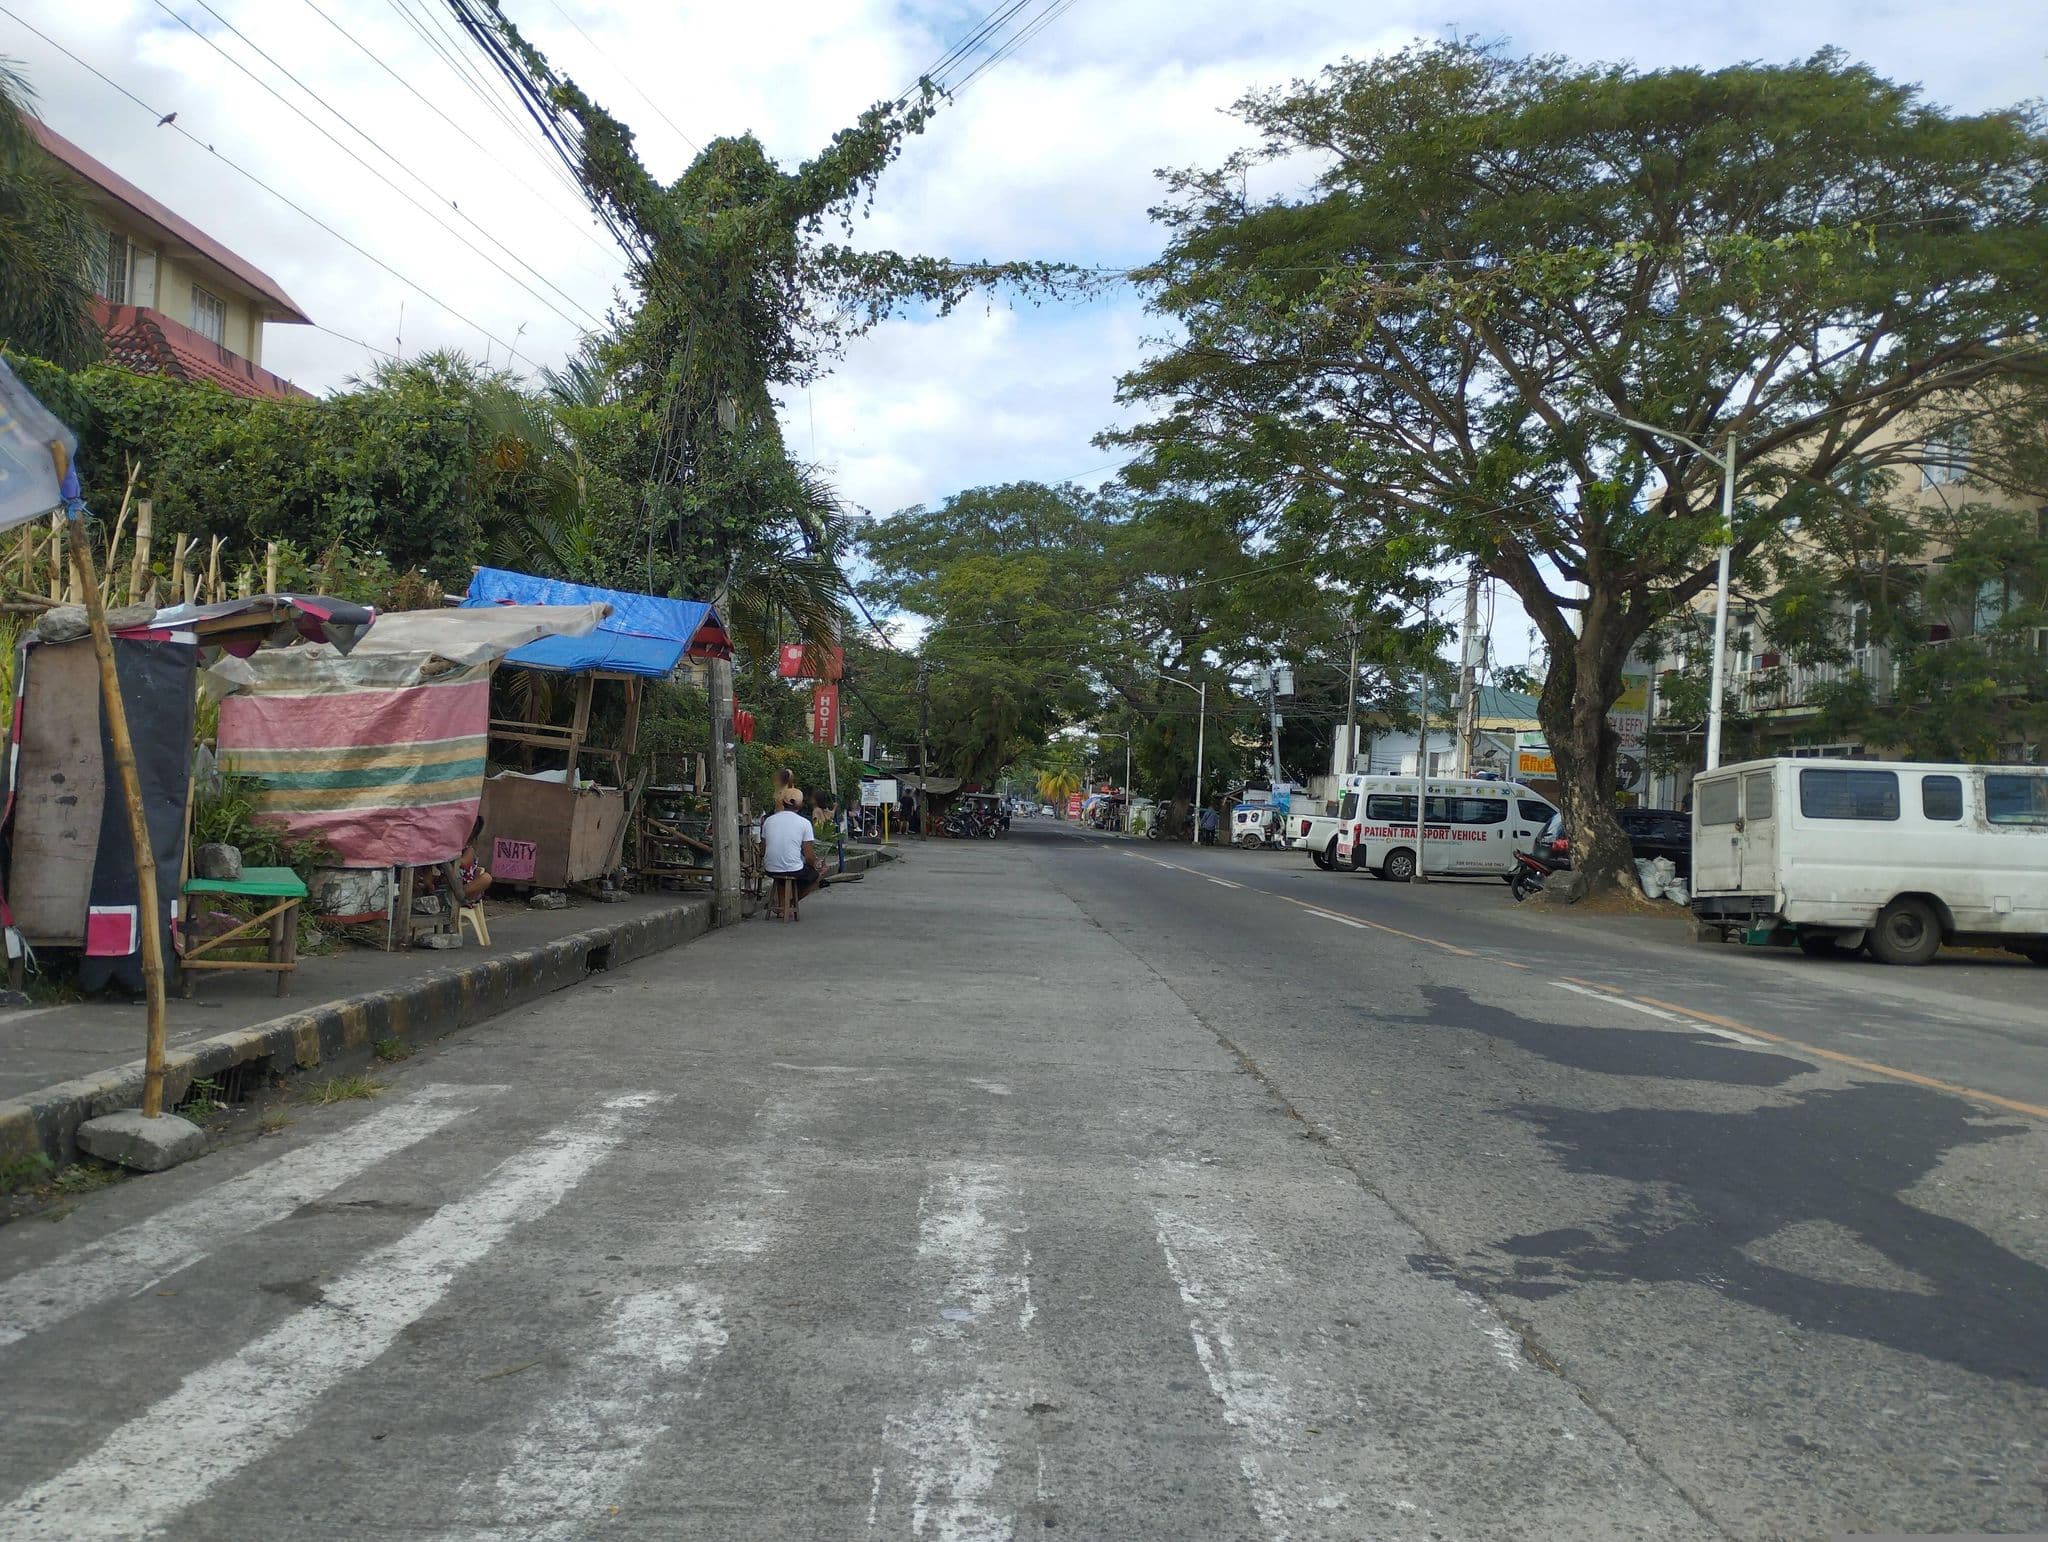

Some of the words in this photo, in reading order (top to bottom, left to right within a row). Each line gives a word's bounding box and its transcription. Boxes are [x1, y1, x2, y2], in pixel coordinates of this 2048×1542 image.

[1364, 826, 1398, 838] PATIENT
[1452, 830, 1487, 842] VEHICLE
[497, 841, 537, 860] NATY
